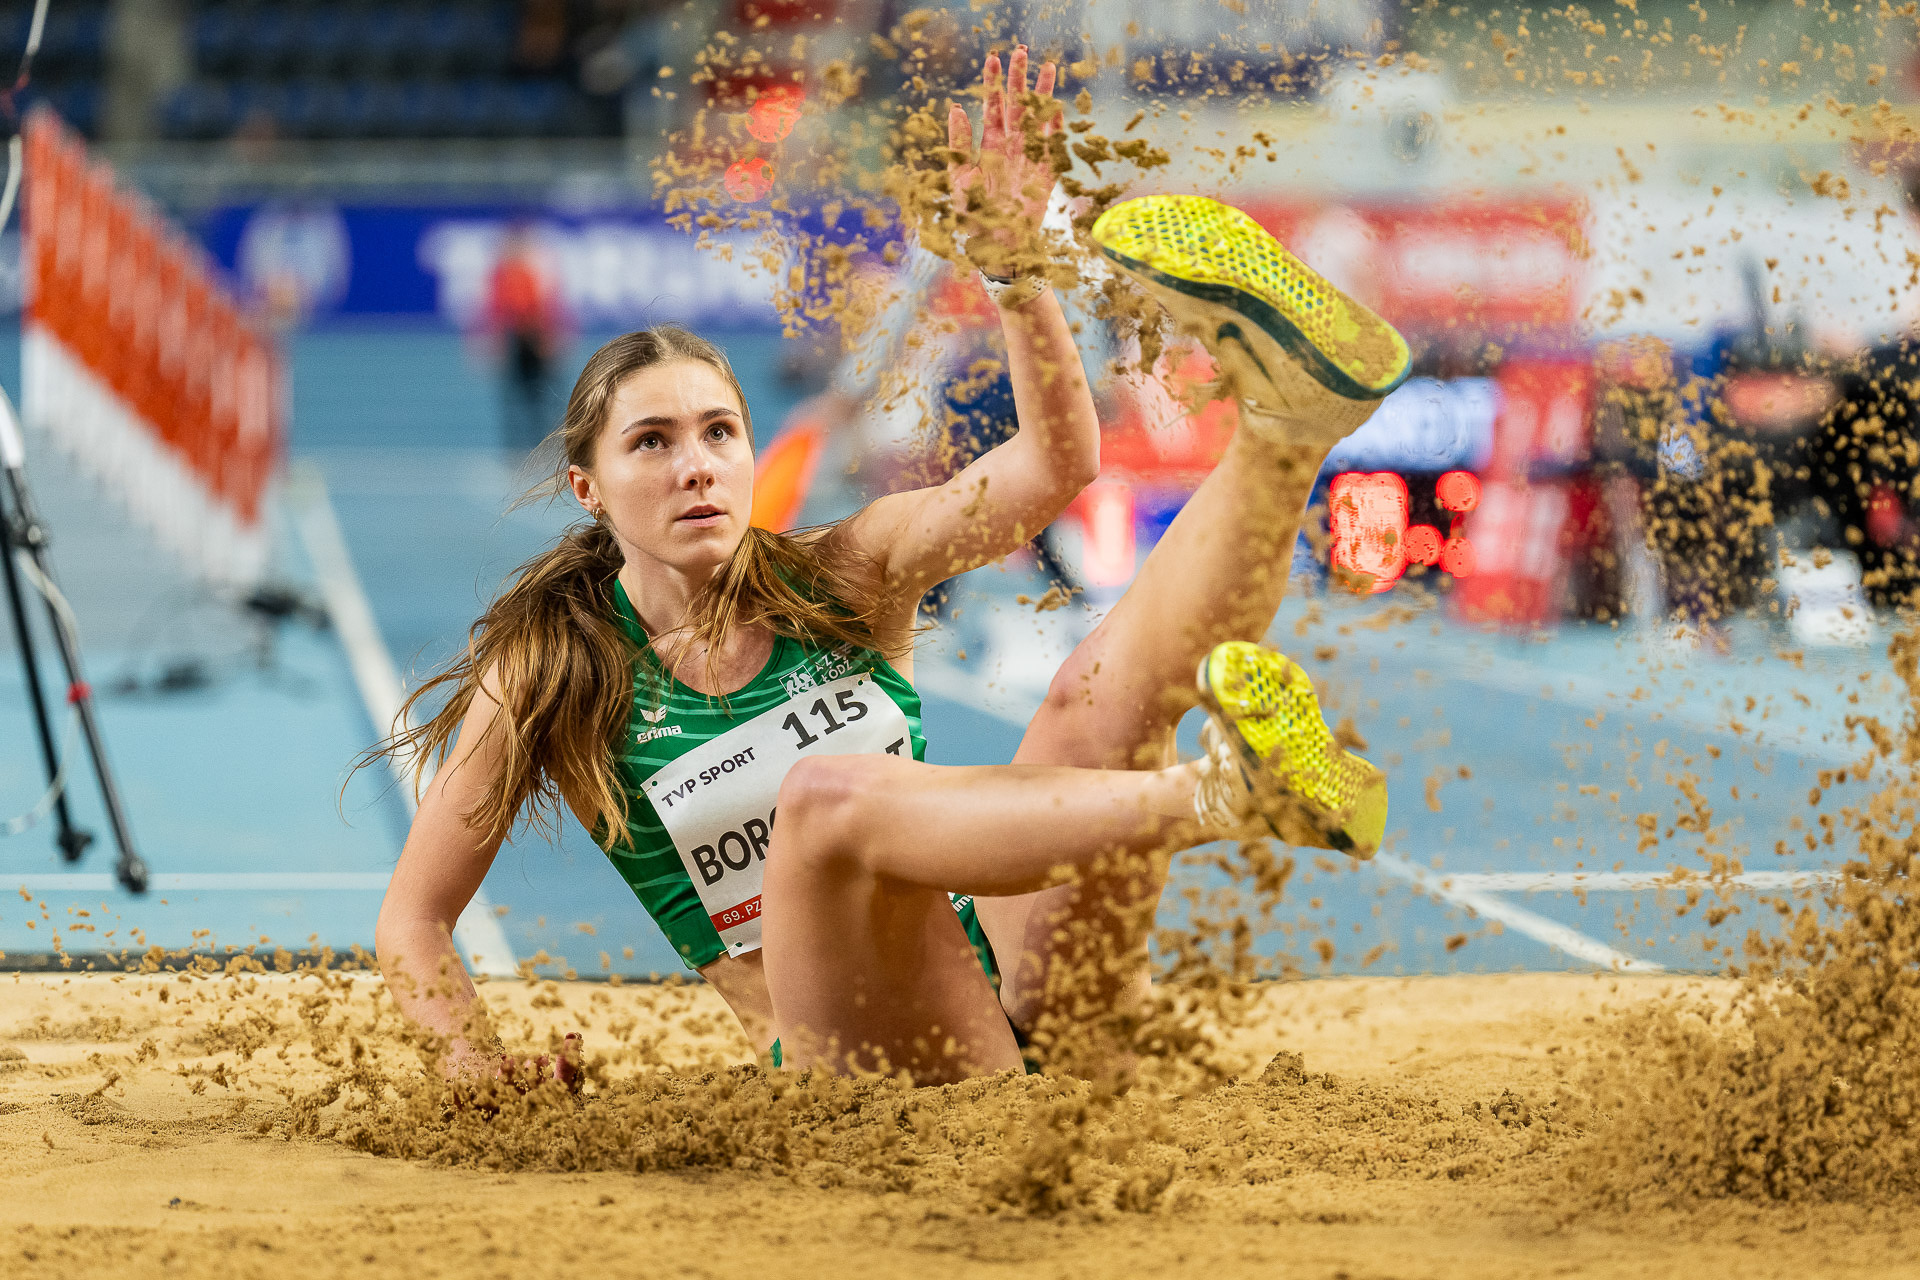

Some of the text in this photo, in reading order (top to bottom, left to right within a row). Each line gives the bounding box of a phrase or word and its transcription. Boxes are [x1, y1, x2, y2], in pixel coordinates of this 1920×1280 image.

[636, 725, 683, 744] erima
[782, 689, 868, 750] 115
[661, 746, 756, 808] TVP SPORT
[690, 806, 778, 887] BOR
[722, 909, 745, 925] 69.
